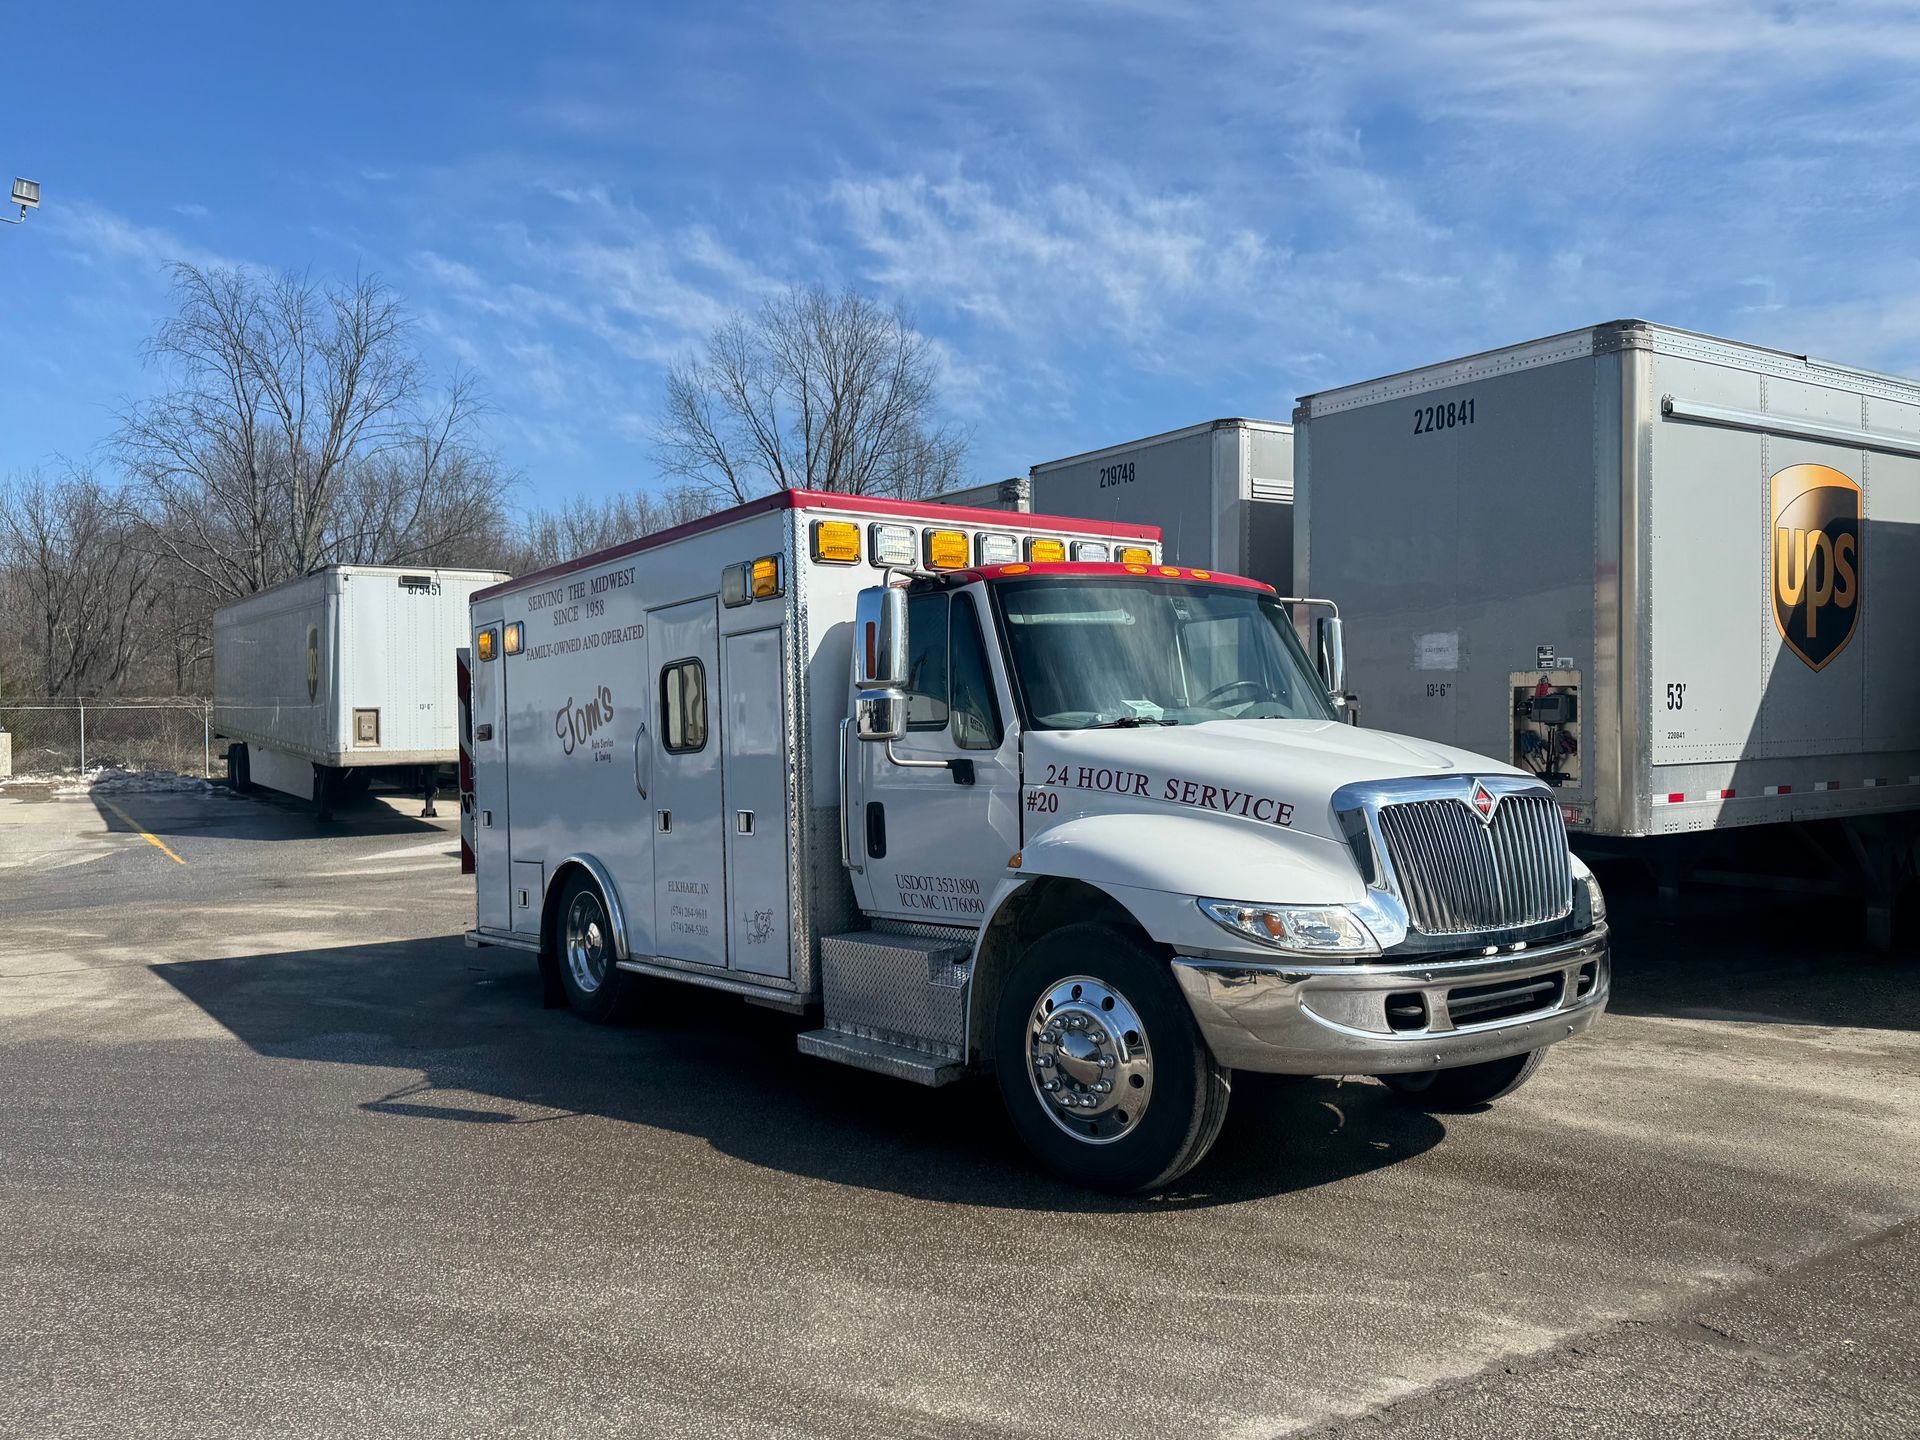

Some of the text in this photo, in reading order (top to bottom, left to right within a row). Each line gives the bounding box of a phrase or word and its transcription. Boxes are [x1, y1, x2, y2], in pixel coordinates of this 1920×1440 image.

[1414, 398, 1475, 435] 220841
[1100, 462, 1135, 488] 219748
[527, 567, 636, 612] SERVING THE MIDWEST
[1778, 527, 1856, 638] ups
[553, 600, 605, 626] SINCE 1958
[526, 624, 645, 661] FAMILY-OWNED AND OPERATED
[1667, 683, 1686, 710] 53'
[556, 685, 614, 755] Tom's
[1667, 731, 1685, 740] 220841
[1026, 792, 1059, 813] #20
[1045, 764, 1295, 827] 24 HOUR SERVICE
[701, 883, 709, 895] IN
[896, 874, 980, 895] USDOT 3531890
[899, 892, 985, 914] ICC MC 1176090
